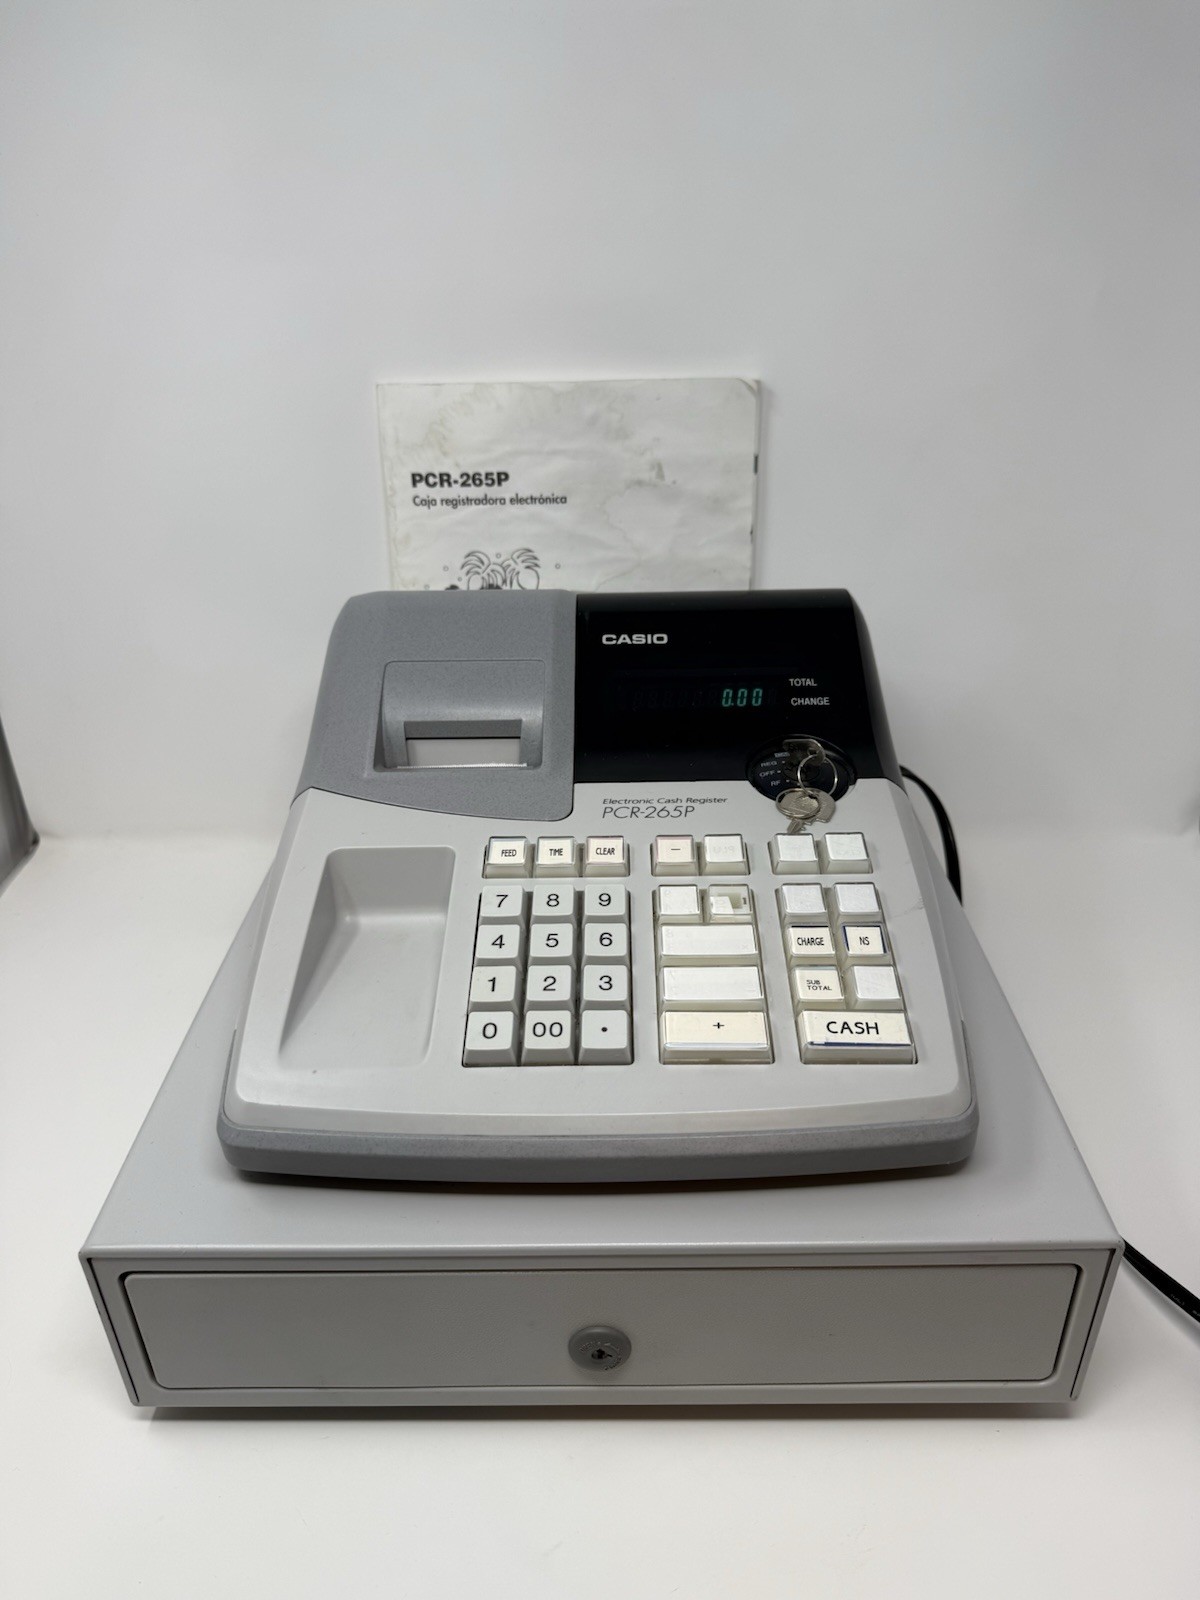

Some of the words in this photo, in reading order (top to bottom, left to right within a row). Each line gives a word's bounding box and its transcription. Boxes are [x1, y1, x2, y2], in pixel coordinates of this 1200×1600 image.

[411, 472, 509, 488] PCR-265P
[412, 495, 437, 509] Caja
[440, 493, 506, 509] registradora
[509, 493, 567, 505] electrónica
[602, 634, 668, 645] CASIO
[789, 678, 817, 686] TOTAL
[722, 688, 763, 707] 0.00
[791, 697, 830, 706] CHANGE
[759, 769, 775, 777] OFF
[603, 797, 653, 805] Electronic
[602, 806, 695, 819] PCR-265P
[501, 849, 517, 857] FEED
[549, 848, 563, 856] TIME
[595, 847, 615, 855] CLEAR
[496, 894, 508, 908] 7
[546, 893, 560, 907] 8
[598, 893, 611, 907] 9
[491, 934, 505, 949] 4
[546, 933, 559, 948] 5
[599, 932, 613, 947] 6
[797, 937, 824, 946] CHARGE
[859, 936, 870, 946] NS
[488, 977, 496, 992] 1
[543, 976, 556, 991] 2
[599, 975, 613, 991] 3
[482, 1022, 497, 1039] 0
[532, 1022, 563, 1037] 00
[826, 1021, 879, 1035] CASH
